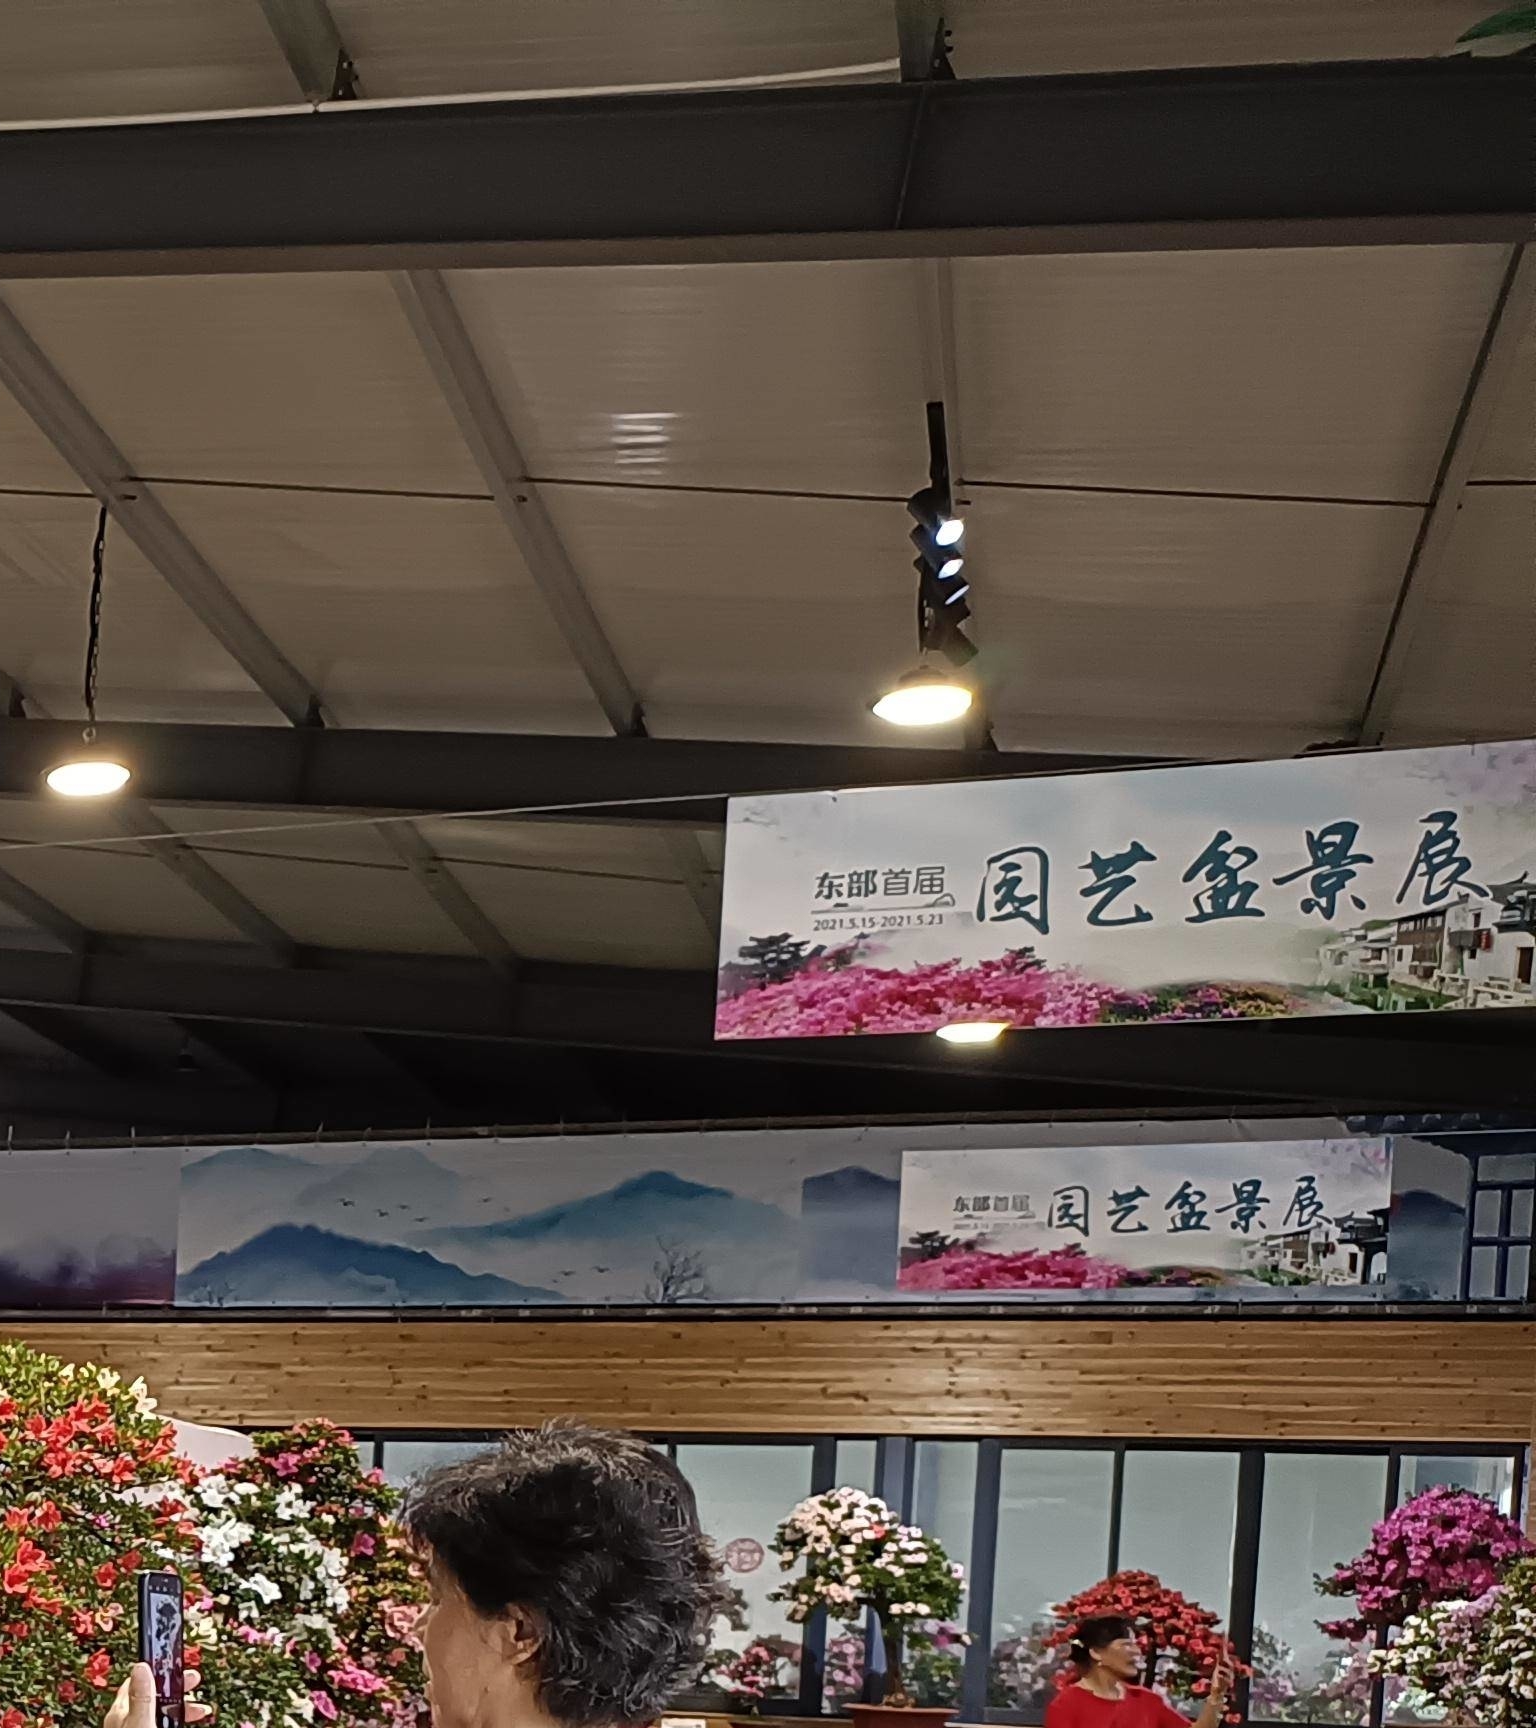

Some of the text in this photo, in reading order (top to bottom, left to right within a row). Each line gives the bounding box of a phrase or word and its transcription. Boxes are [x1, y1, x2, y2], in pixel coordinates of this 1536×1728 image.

[814, 865, 946, 900] 东部首届
[975, 808, 1495, 936] 园艺盆景展
[1047, 1175, 1333, 1236] 园艺盆景展
